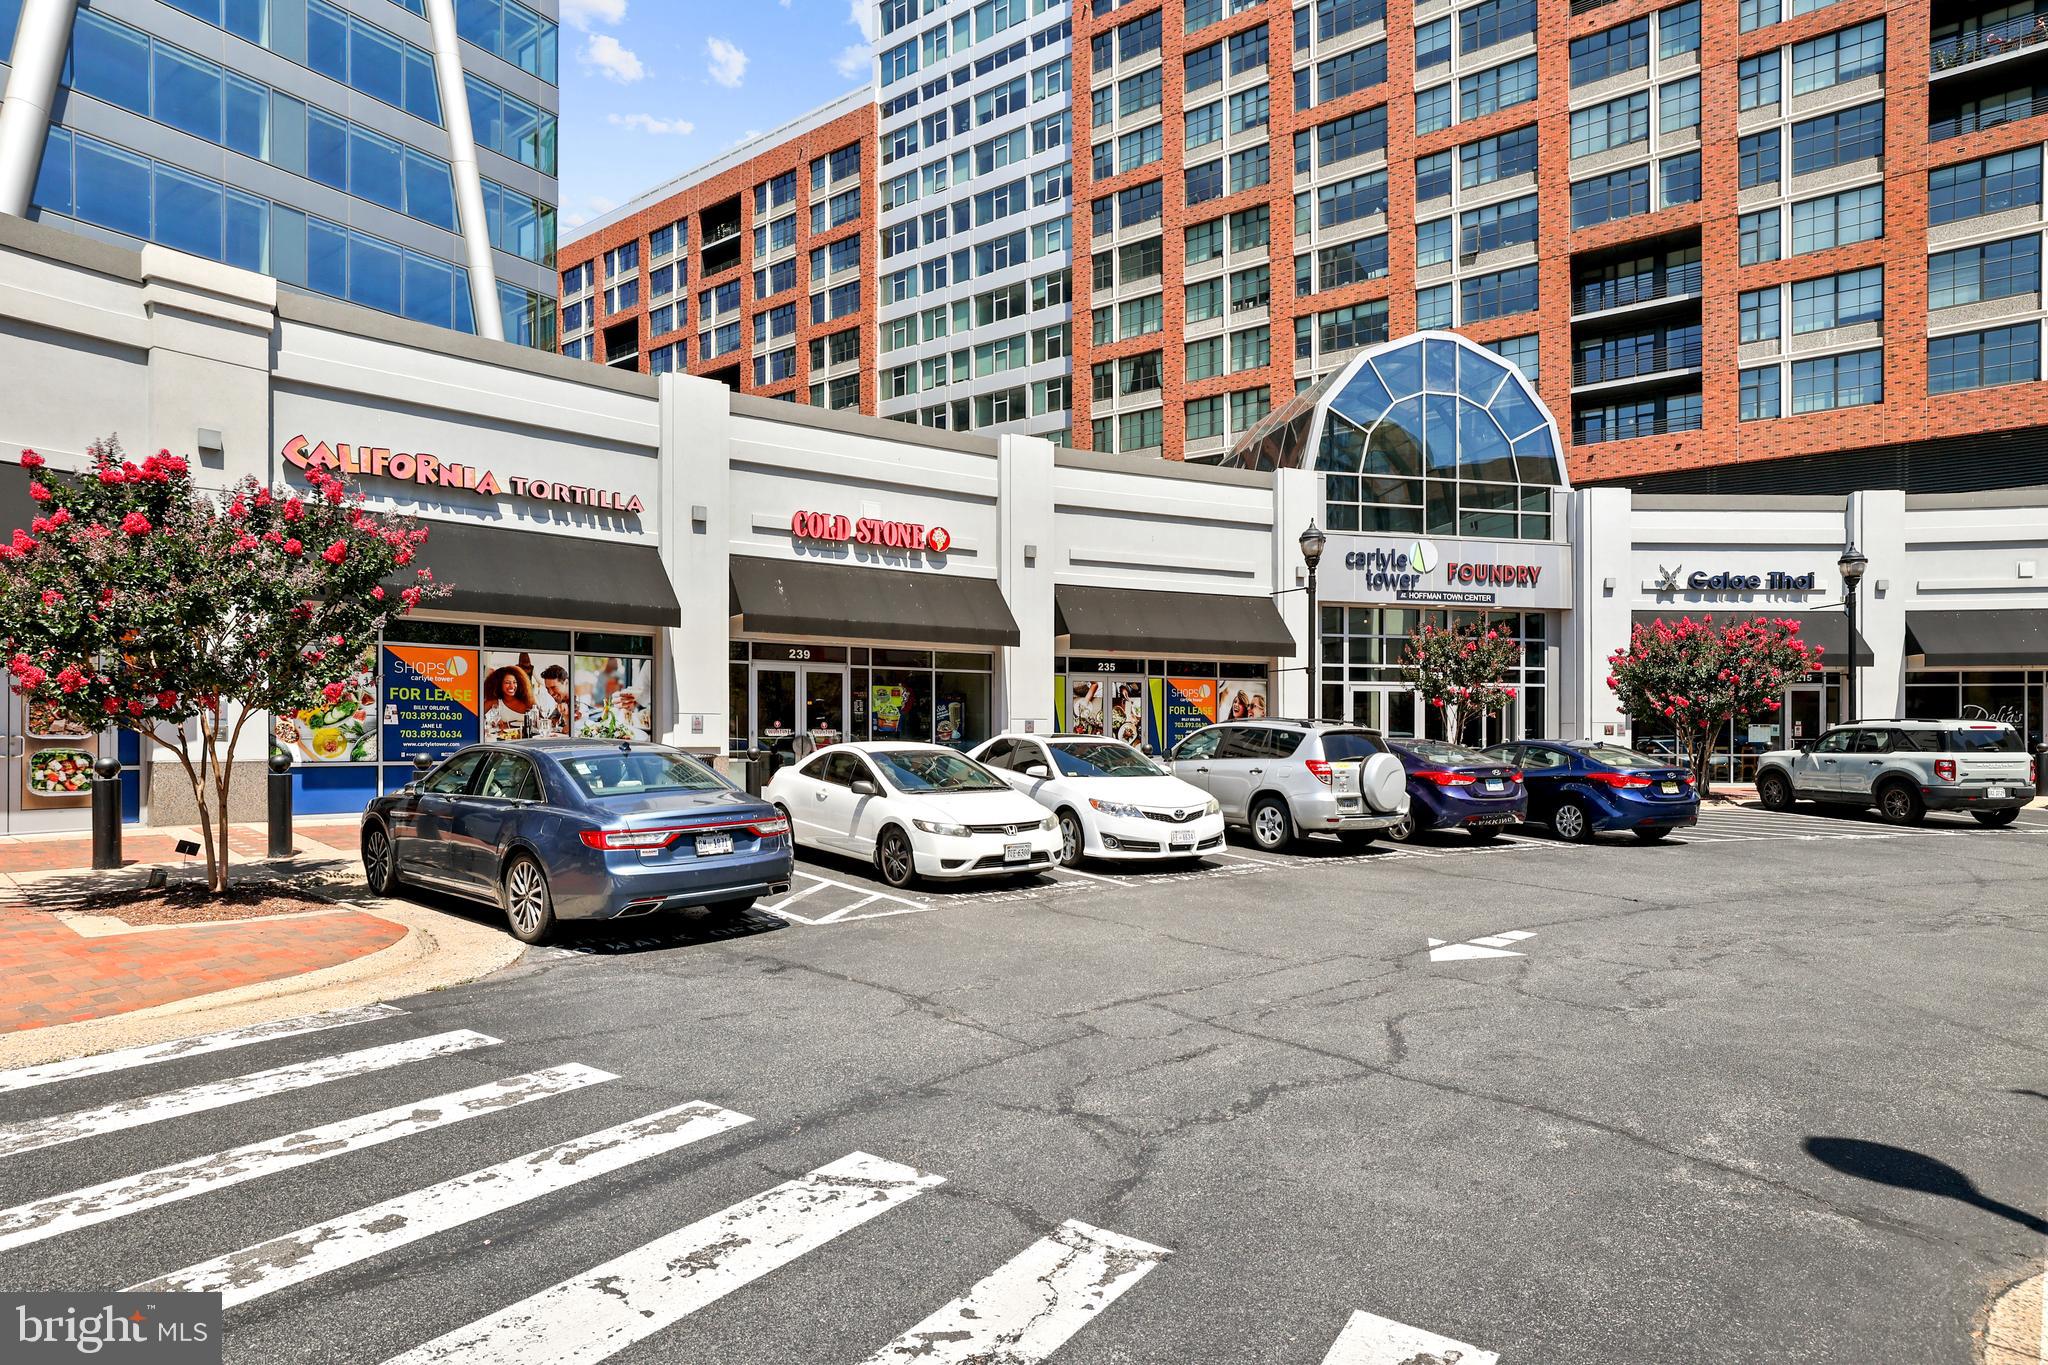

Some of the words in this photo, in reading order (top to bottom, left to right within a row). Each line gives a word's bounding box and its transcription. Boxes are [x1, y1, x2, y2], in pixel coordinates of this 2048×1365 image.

[281, 434, 502, 495] CALIFORNIA
[510, 476, 645, 513] TORTILLA
[791, 510, 850, 541] COLD
[856, 517, 926, 550] STONE
[1345, 548, 1408, 571] carlyle
[1365, 569, 1421, 588] tower
[1447, 562, 1542, 585] FOUNDRY
[1687, 571, 1761, 590] Galae
[1768, 571, 1815, 589] Thai
[1408, 592, 1441, 600] HOFFMAN
[1443, 593, 1463, 601] TOWN
[1464, 594, 1492, 602] CENTER
[788, 649, 811, 660] 239
[394, 660, 446, 675] SHOPS
[1098, 662, 1116, 672] 235
[410, 674, 434, 683] carlyle
[434, 675, 454, 683] tower
[389, 687, 420, 700] FOR
[425, 688, 472, 702] LEASE
[1171, 688, 1199, 698] SHOPS
[400, 711, 463, 721] 703.893.0630
[1169, 706, 1186, 715] FOR
[1187, 706, 1213, 716] LEASE
[400, 730, 463, 739] 703.893.0634
